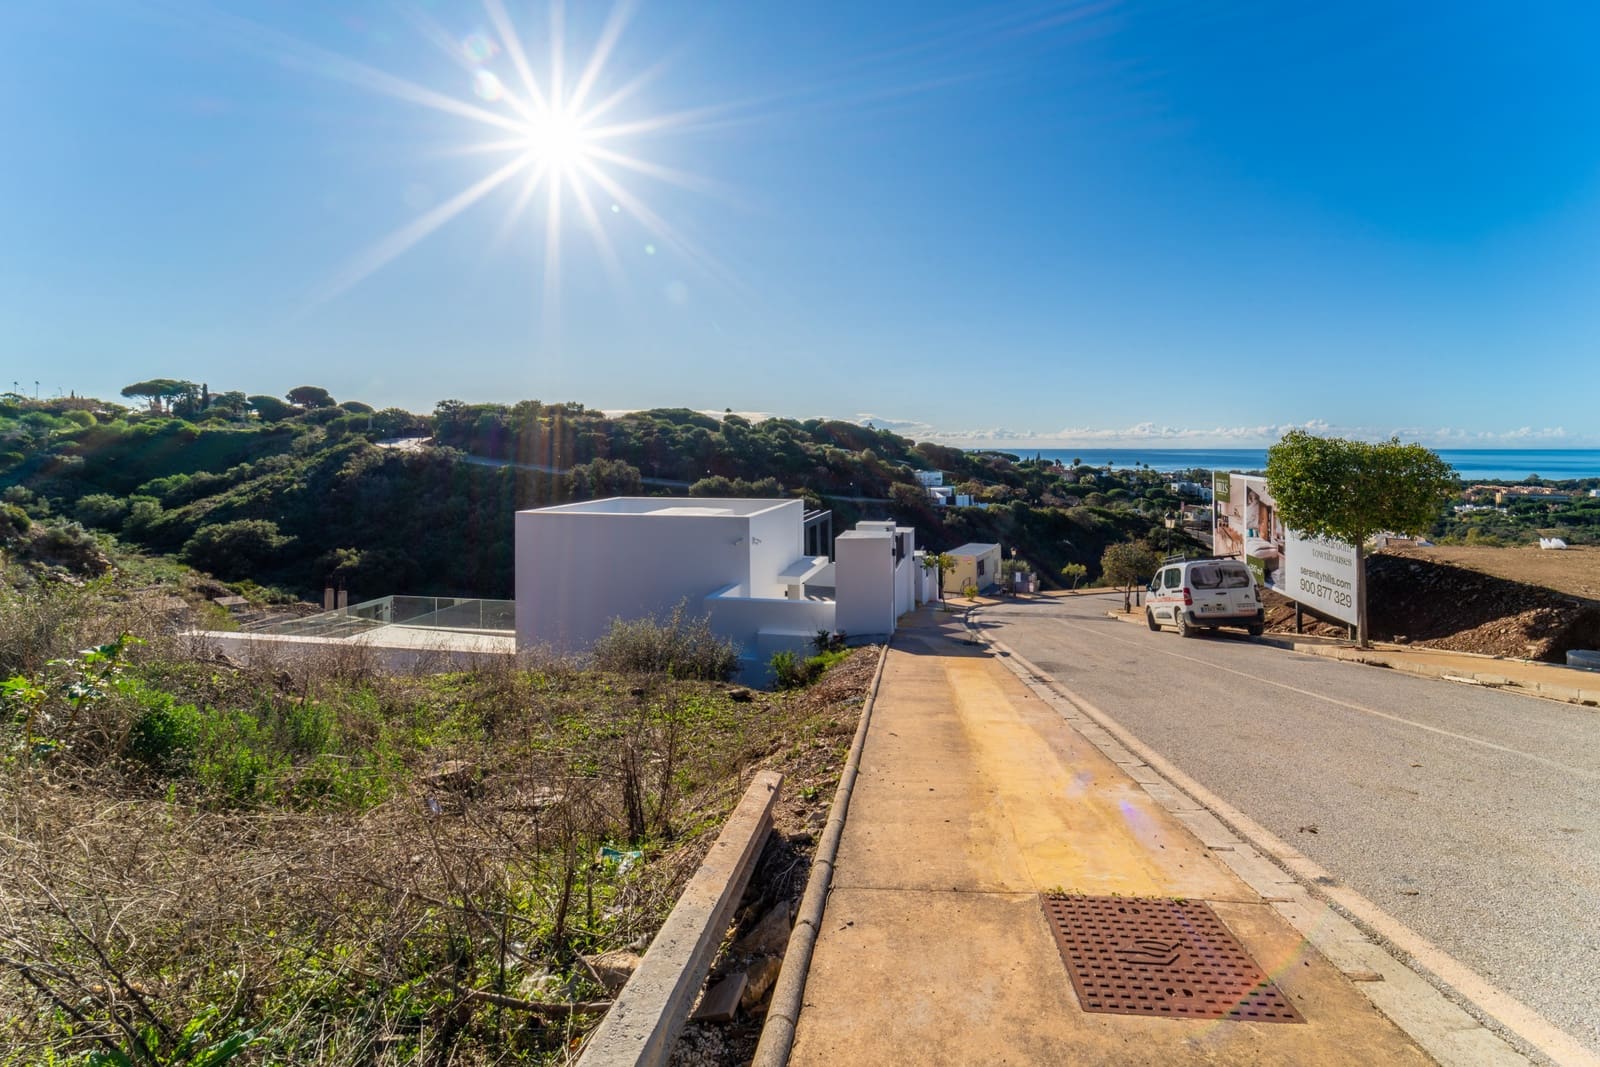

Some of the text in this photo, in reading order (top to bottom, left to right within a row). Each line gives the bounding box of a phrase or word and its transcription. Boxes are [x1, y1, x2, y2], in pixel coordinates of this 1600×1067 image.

[1312, 548, 1352, 567] townhouses
[1300, 566, 1352, 591] serenityhills.com
[1300, 578, 1353, 608] 900 877 329
